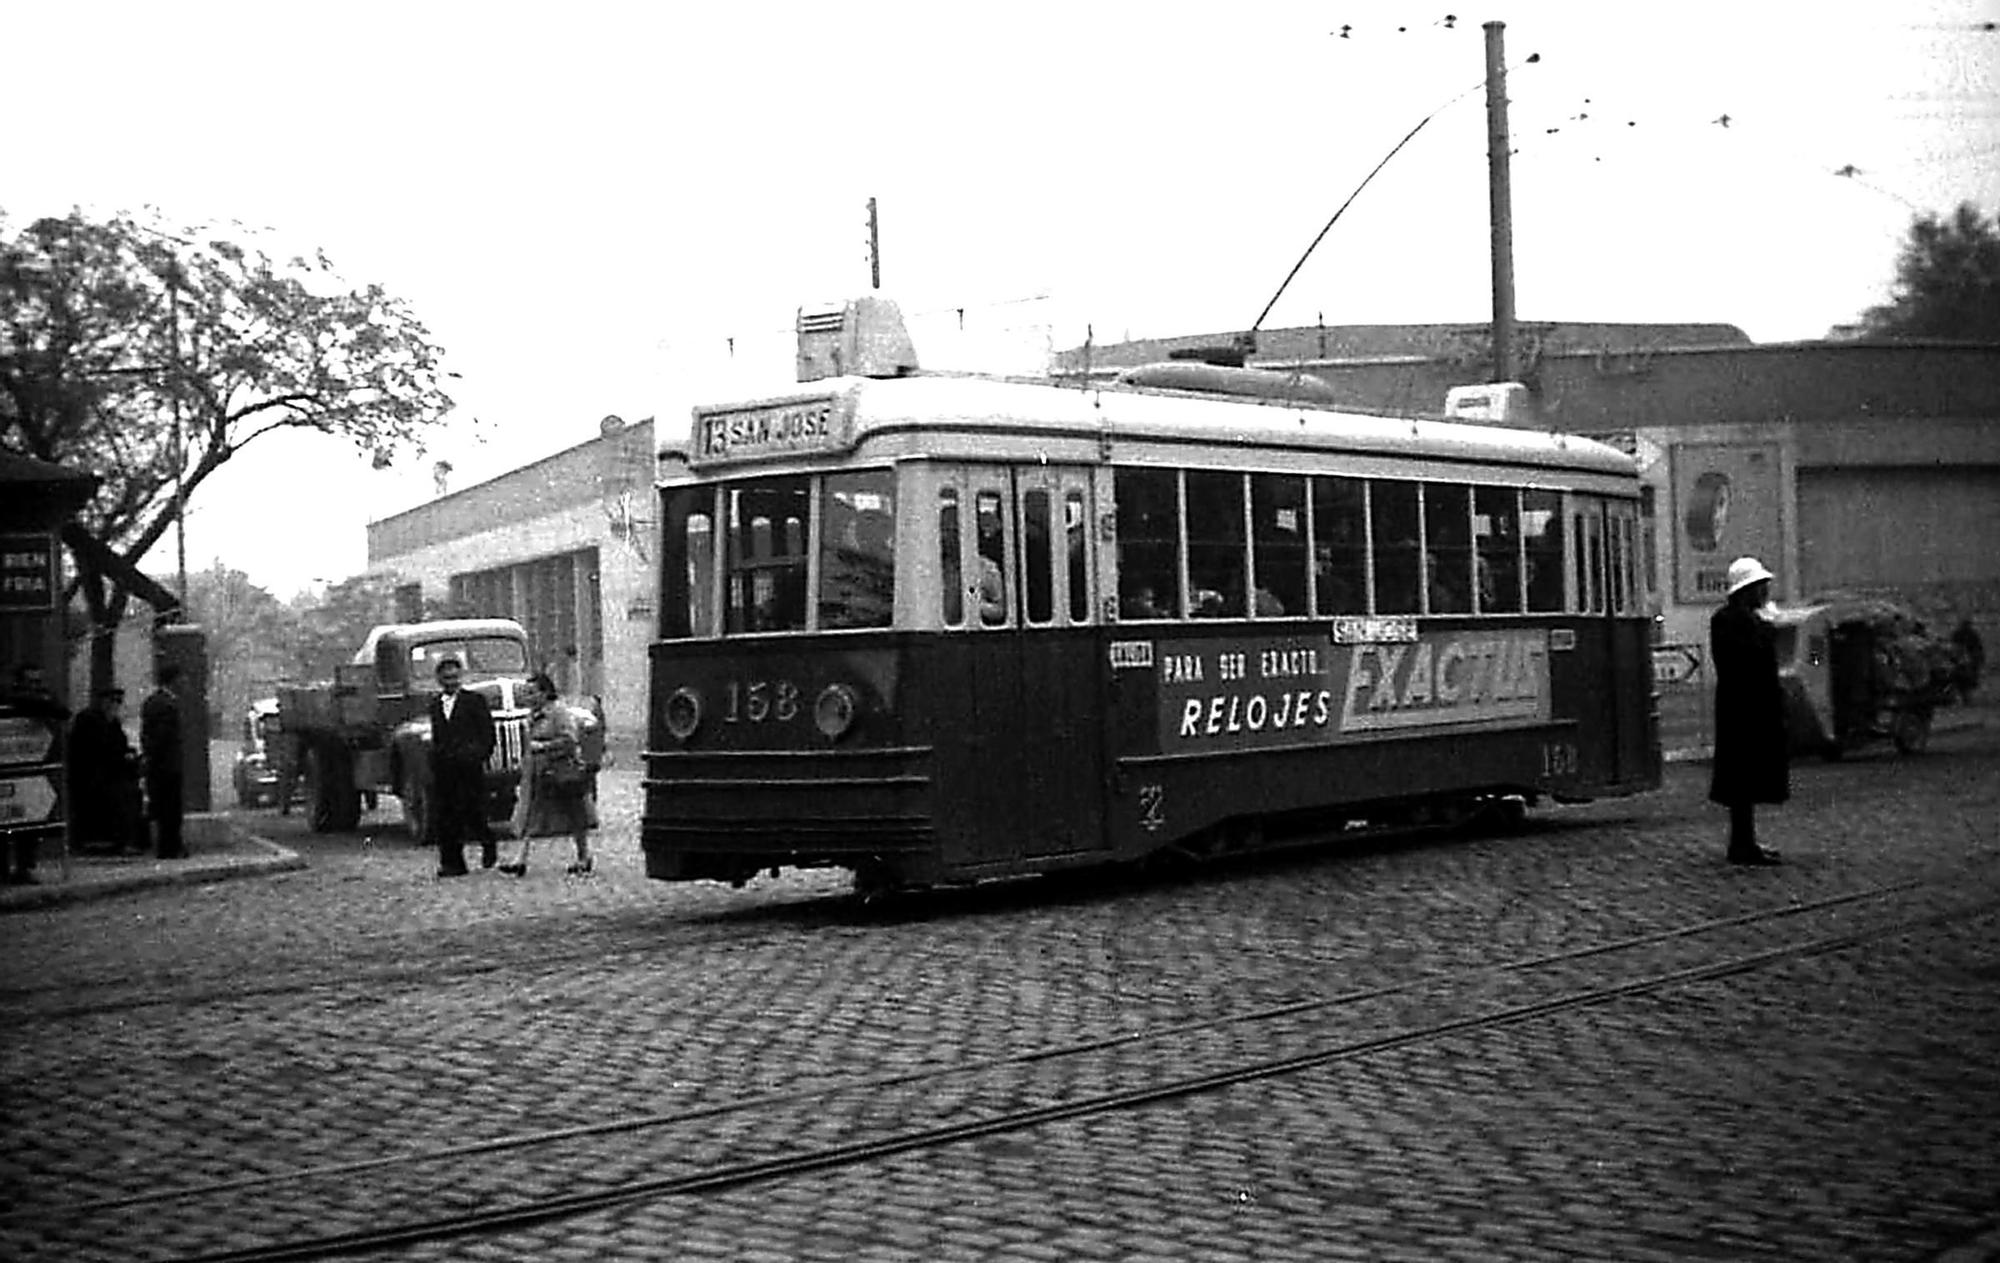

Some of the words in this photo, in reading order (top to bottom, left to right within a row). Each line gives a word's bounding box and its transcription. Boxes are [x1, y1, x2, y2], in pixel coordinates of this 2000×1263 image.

[1164, 656, 1203, 683] PARA
[1219, 653, 1246, 680] SER
[1180, 690, 1331, 736] RELOJES
